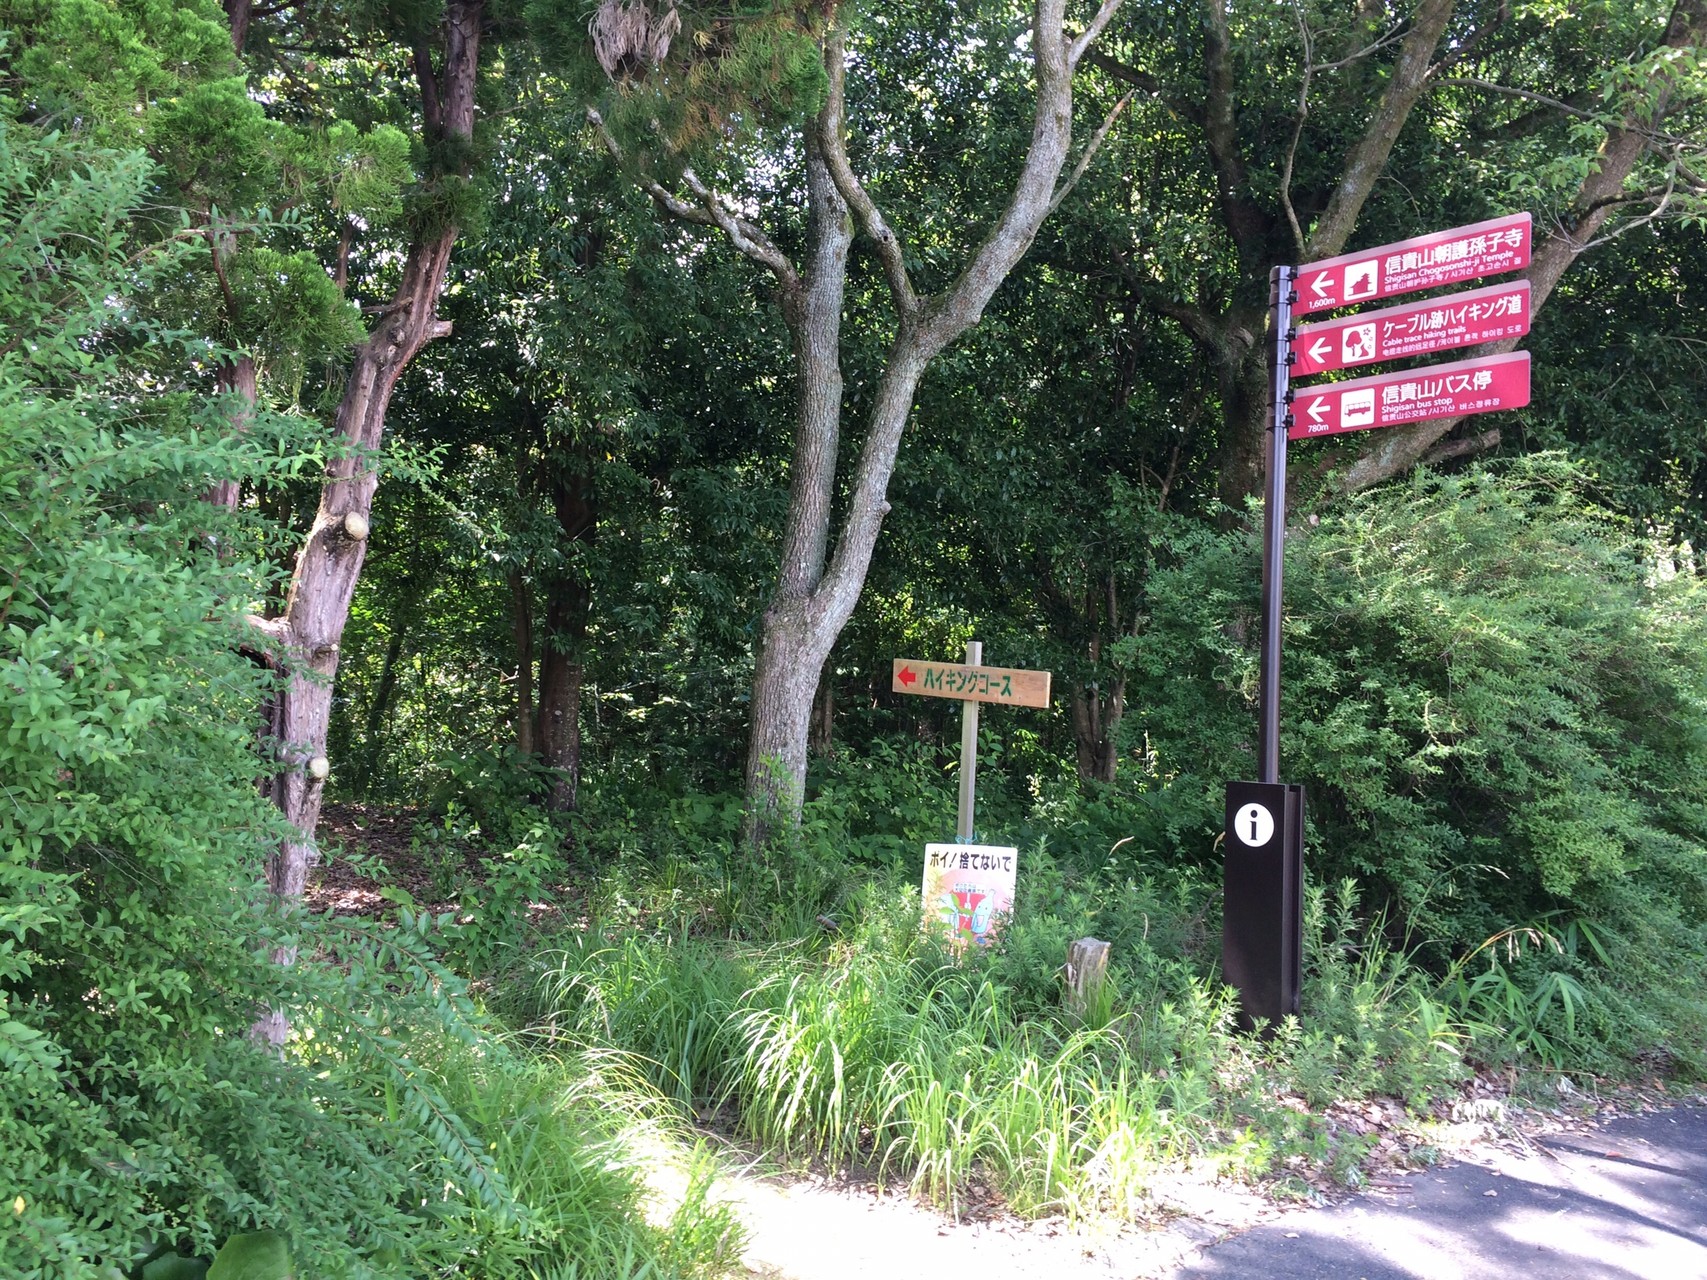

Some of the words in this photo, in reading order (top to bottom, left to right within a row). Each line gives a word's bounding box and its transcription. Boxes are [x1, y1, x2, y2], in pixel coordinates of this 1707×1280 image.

[1385, 228, 1523, 275] 信貴山朝護孫子寺
[1384, 271, 1417, 285] Shigisan
[1418, 257, 1480, 277] Chogosonshi-ji
[1482, 250, 1514, 264] Temple
[1308, 297, 1336, 309] 1,600m
[1383, 294, 1522, 338] ケーブル跡ハイキング道
[1382, 335, 1403, 347] Cable
[1404, 333, 1422, 344] trace
[1423, 328, 1447, 340] hiking
[1447, 325, 1466, 335] trails
[1381, 370, 1492, 405] 信貴山バス停
[1381, 402, 1415, 414] Shigisan
[1416, 400, 1432, 410] bus
[1433, 397, 1453, 407] stop
[1307, 424, 1329, 433] 780m
[923, 668, 1012, 697] ハイキングコース
